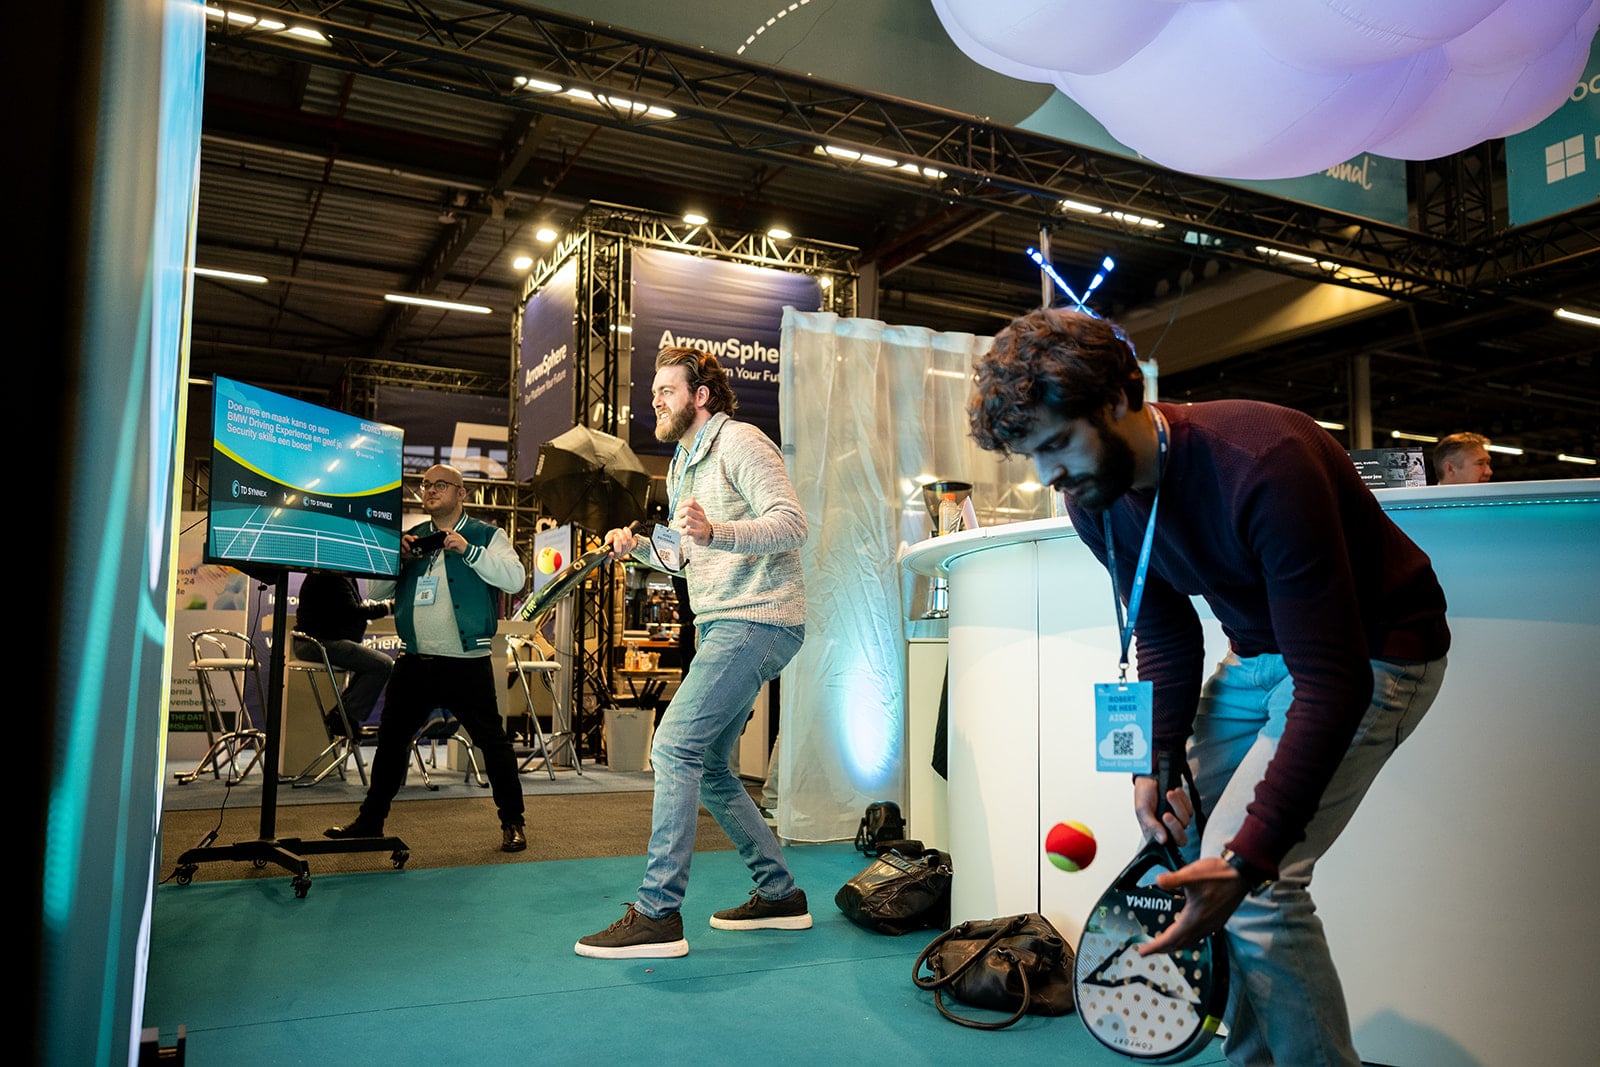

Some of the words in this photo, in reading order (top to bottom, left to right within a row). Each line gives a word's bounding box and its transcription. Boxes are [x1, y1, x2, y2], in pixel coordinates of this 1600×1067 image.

[1326, 156, 1372, 190] onal
[658, 330, 780, 365] ArrowSphe
[525, 344, 567, 388] ArrowSphere
[736, 367, 761, 380] Your
[228, 400, 243, 411] Doe
[244, 406, 260, 416] mee
[261, 411, 271, 419] en
[271, 413, 290, 425] maak
[292, 417, 307, 430] kans
[308, 423, 317, 432] op
[318, 427, 330, 435] een
[228, 411, 248, 424] BMW
[249, 417, 274, 433] Driving
[276, 424, 312, 441] Experience
[227, 422, 257, 440] Security
[258, 431, 276, 443] skills
[278, 438, 291, 447] een
[241, 486, 247, 495] TD
[248, 488, 267, 497] SYNNEX
[317, 501, 333, 509] SYNNEX
[378, 511, 392, 521] SYNNEX
[173, 677, 200, 685] rancis
[171, 687, 192, 695] ornia
[170, 698, 202, 706] vember
[1126, 895, 1172, 911] KUIKMA
